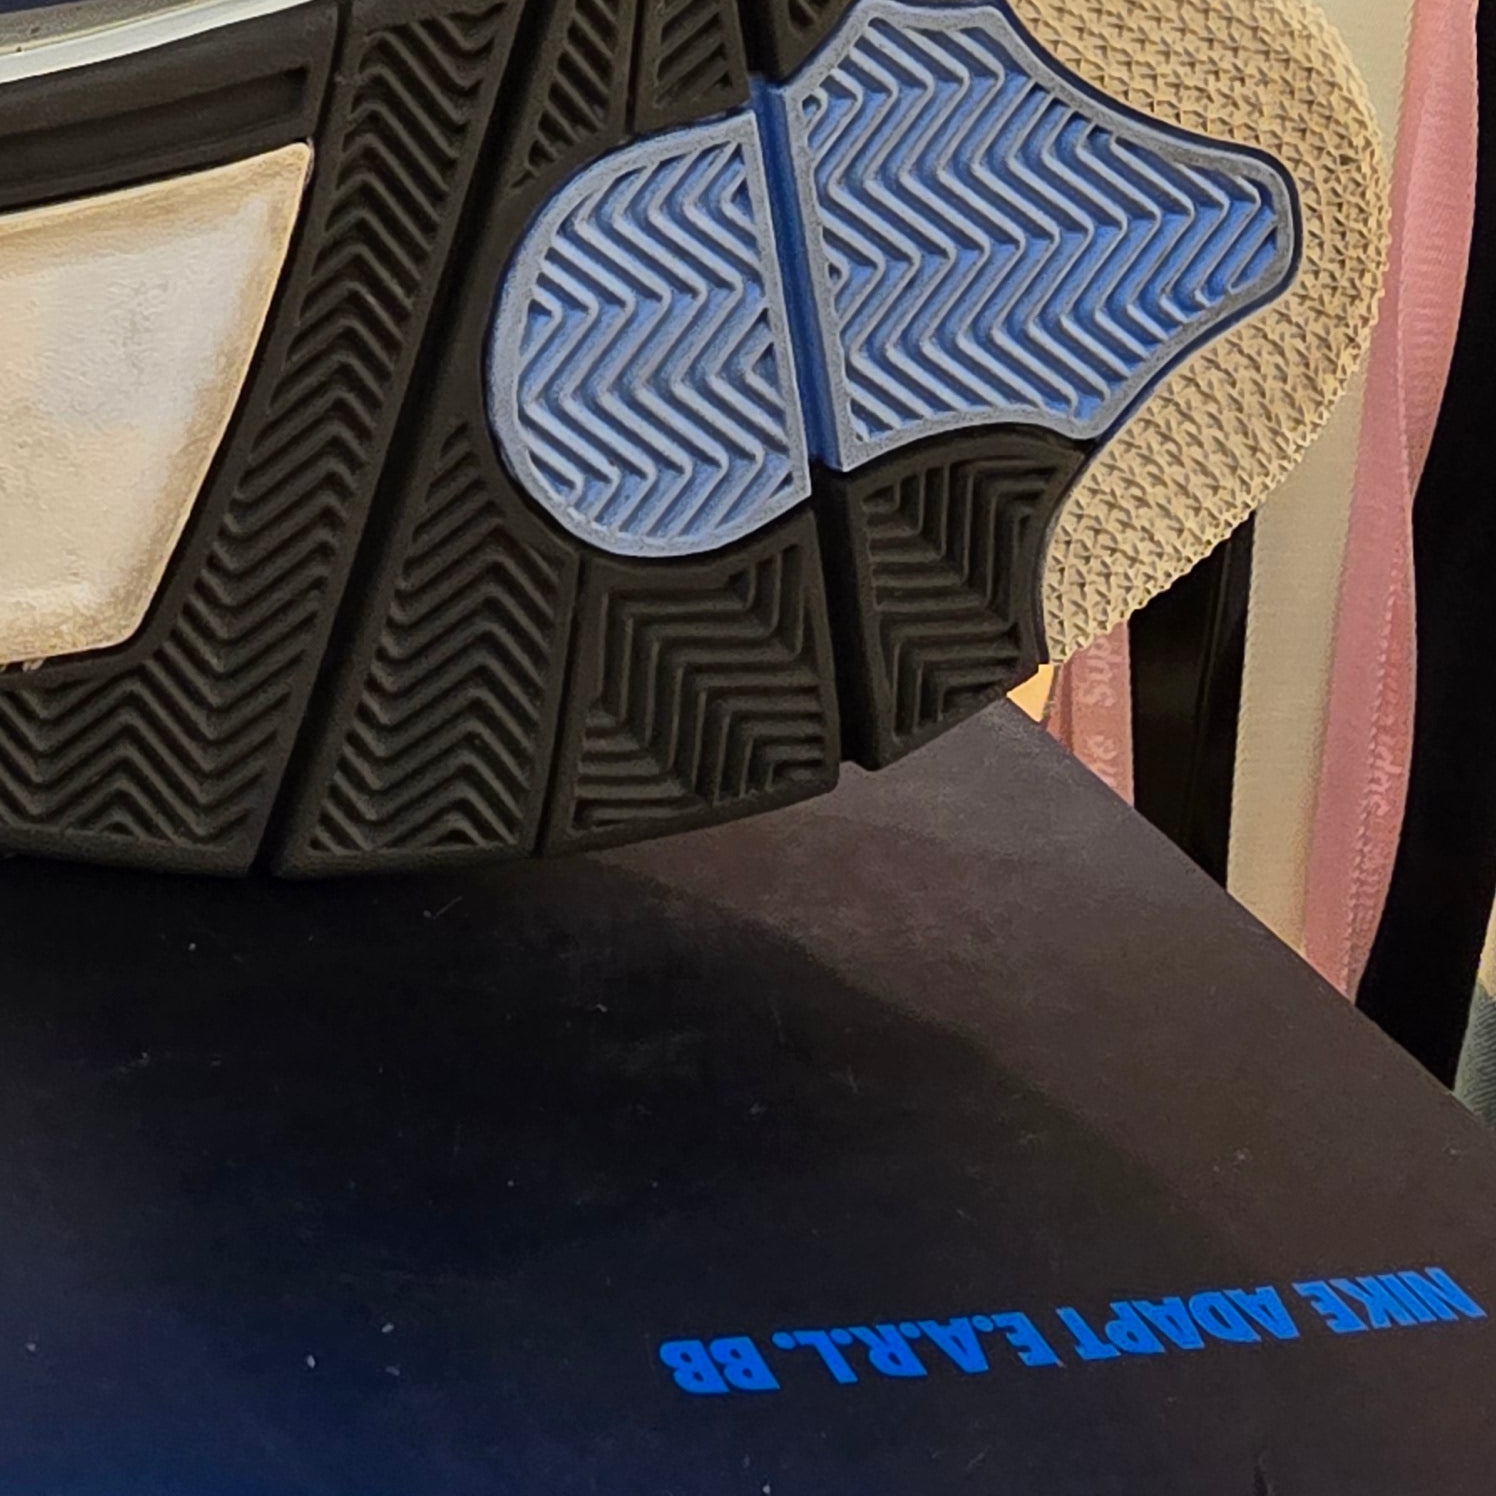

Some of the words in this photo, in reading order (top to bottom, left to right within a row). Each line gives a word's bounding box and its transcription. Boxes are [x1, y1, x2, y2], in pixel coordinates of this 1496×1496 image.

[1056, 1286, 1300, 1361] ADAPT
[1292, 1267, 1488, 1334] NIKE
[659, 1336, 781, 1394] BB
[772, 1311, 1063, 1384] E.A.R.L.
